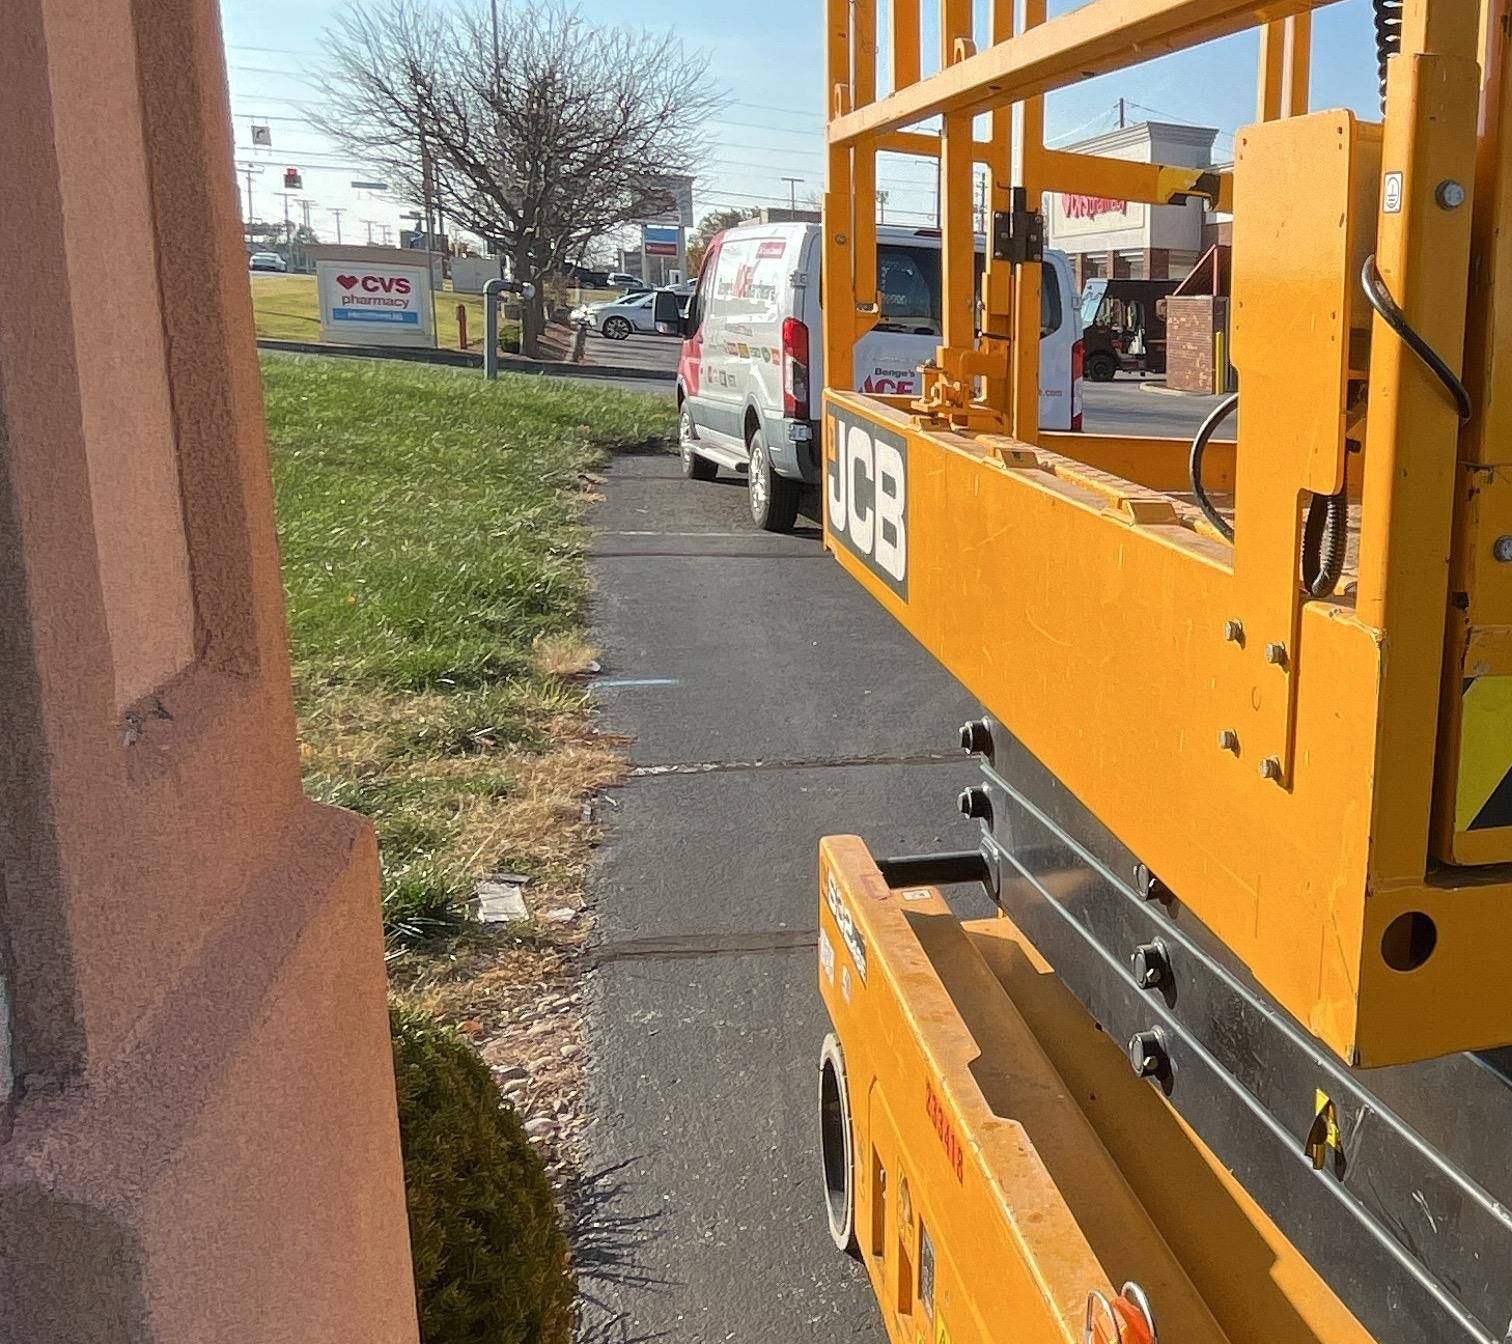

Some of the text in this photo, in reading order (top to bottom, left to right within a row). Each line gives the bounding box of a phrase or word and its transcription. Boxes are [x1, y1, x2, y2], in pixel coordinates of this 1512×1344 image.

[361, 275, 411, 294] CVS
[341, 294, 410, 310] pharmacy
[828, 420, 907, 582] JCB
